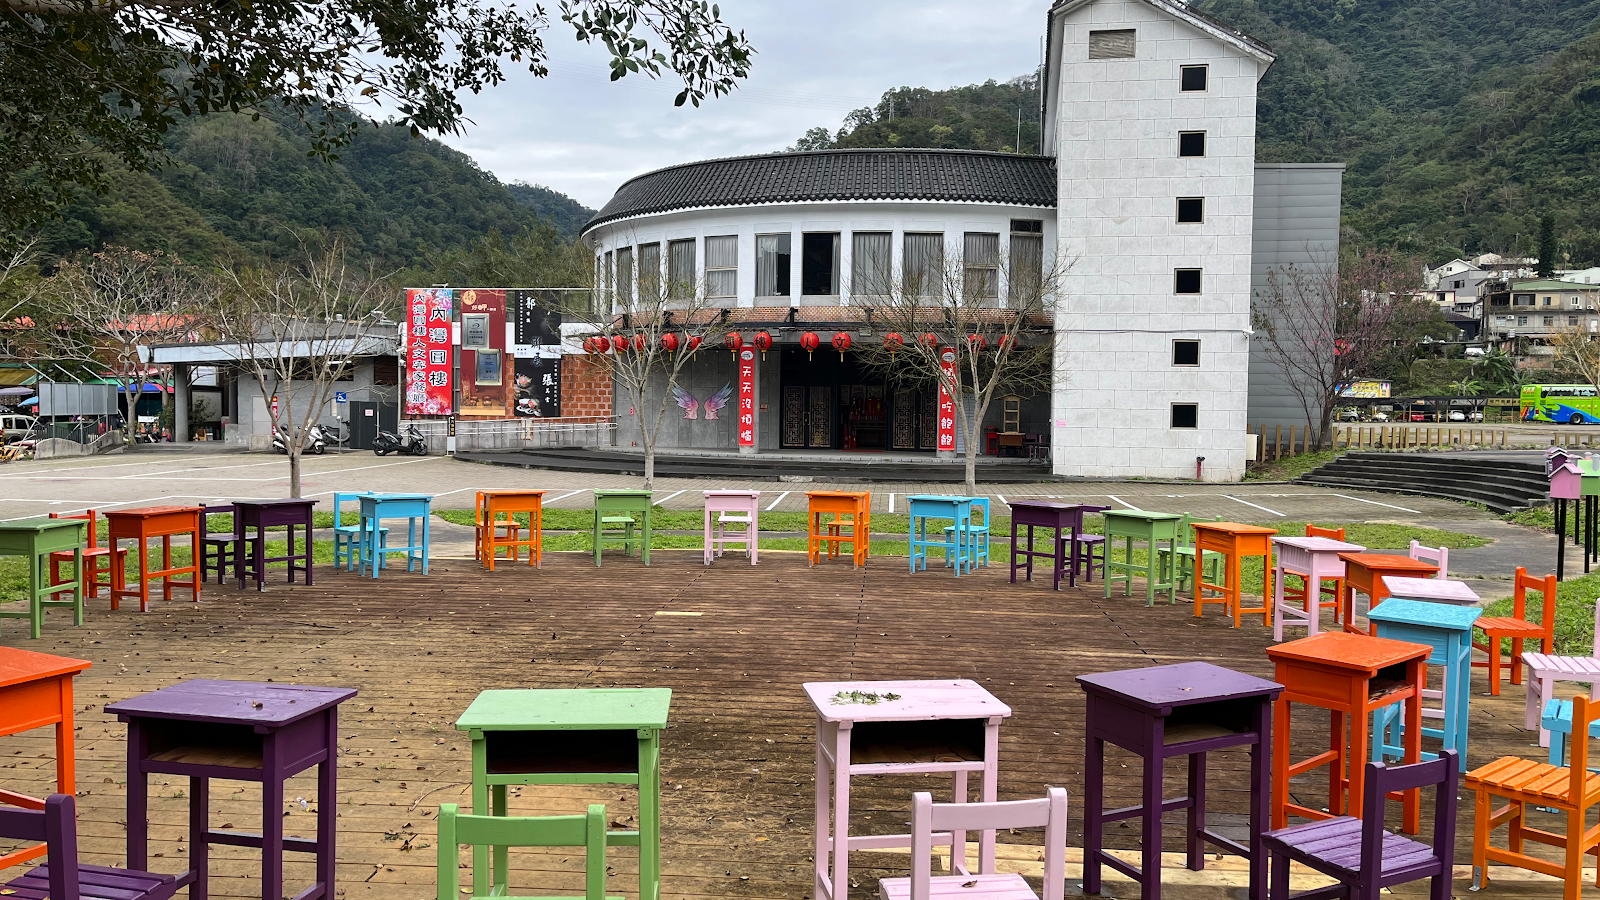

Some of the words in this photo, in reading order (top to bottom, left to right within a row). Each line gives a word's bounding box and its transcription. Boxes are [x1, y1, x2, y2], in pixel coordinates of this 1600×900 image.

[429, 307, 447, 386] 內灣圓樓
[741, 366, 752, 442] 天天沒煩惱
